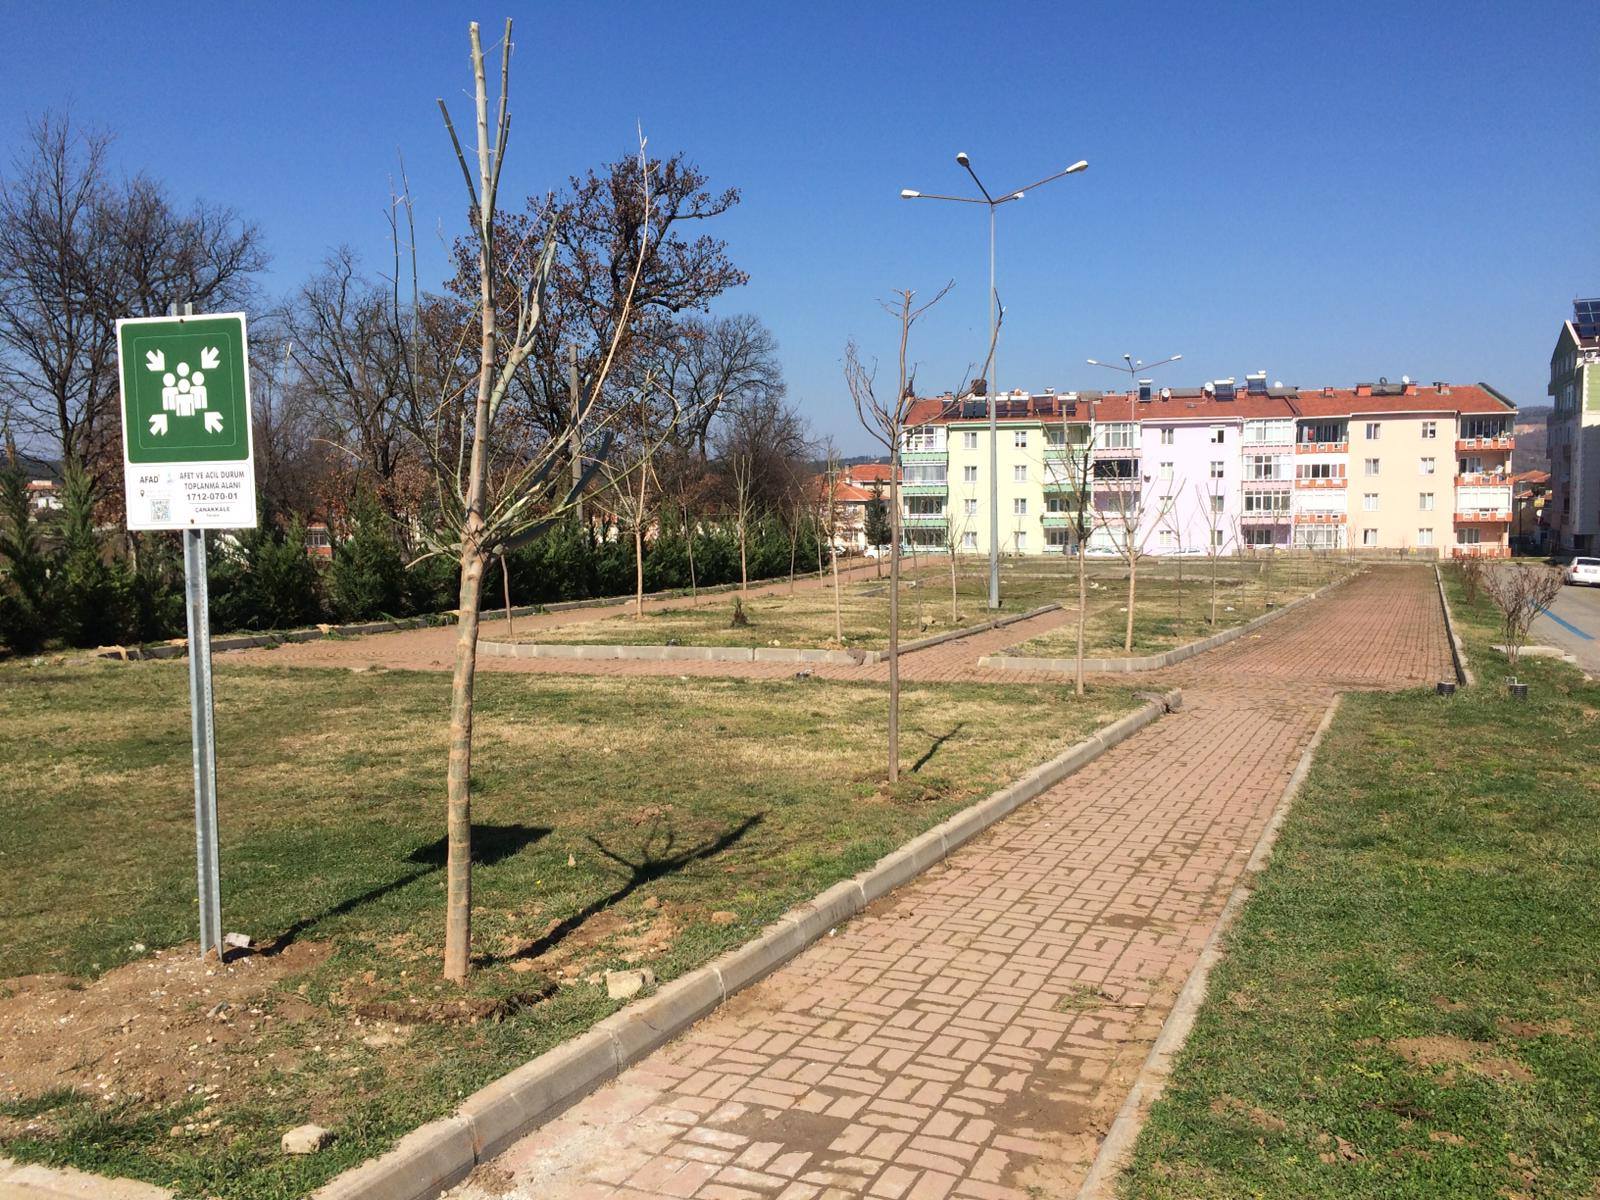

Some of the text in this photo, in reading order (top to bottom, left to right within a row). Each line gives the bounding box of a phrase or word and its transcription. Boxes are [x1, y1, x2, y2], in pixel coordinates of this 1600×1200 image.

[179, 472, 194, 480] AFET
[220, 471, 245, 479] DURUM
[184, 482, 220, 490] TOPLANMA
[186, 492, 238, 500] 1712-070-01
